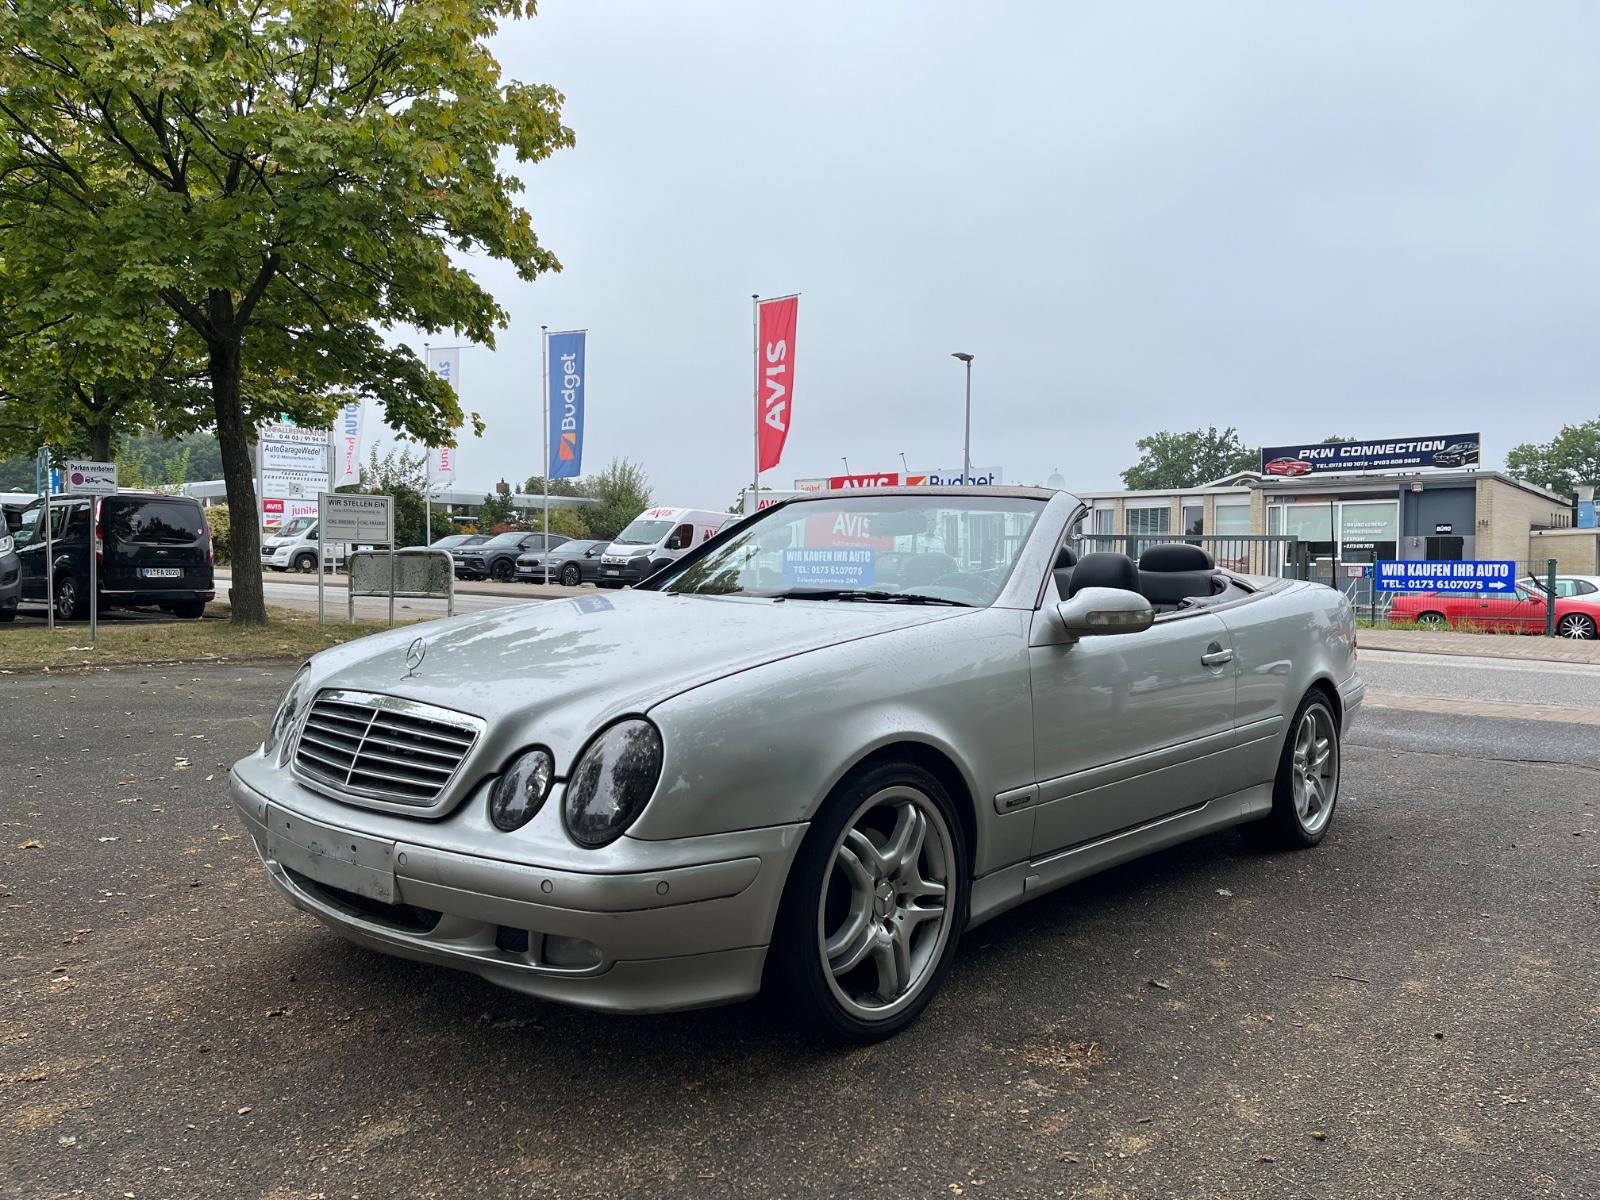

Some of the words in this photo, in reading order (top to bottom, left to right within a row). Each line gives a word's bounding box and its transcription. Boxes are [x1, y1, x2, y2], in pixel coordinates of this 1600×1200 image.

[561, 353, 580, 430] Budget
[765, 340, 787, 432] AVIS
[1298, 448, 1335, 460] PKW
[1340, 440, 1446, 457] CONNECTION
[647, 509, 673, 517] AVIS
[787, 551, 803, 562] WIR
[804, 551, 833, 562] KAUFEN
[834, 551, 848, 562] IHR
[793, 566, 810, 574] TEL:
[811, 566, 829, 574] 0173
[830, 566, 863, 575] 6107075
[1382, 564, 1405, 576] WIR
[1407, 564, 1451, 576] KAUFEN
[1453, 564, 1474, 576] IHR
[1476, 564, 1509, 577] AUTO
[1382, 580, 1405, 588] TEL:
[1408, 580, 1434, 588] 0173
[1436, 580, 1483, 589] 6107075
